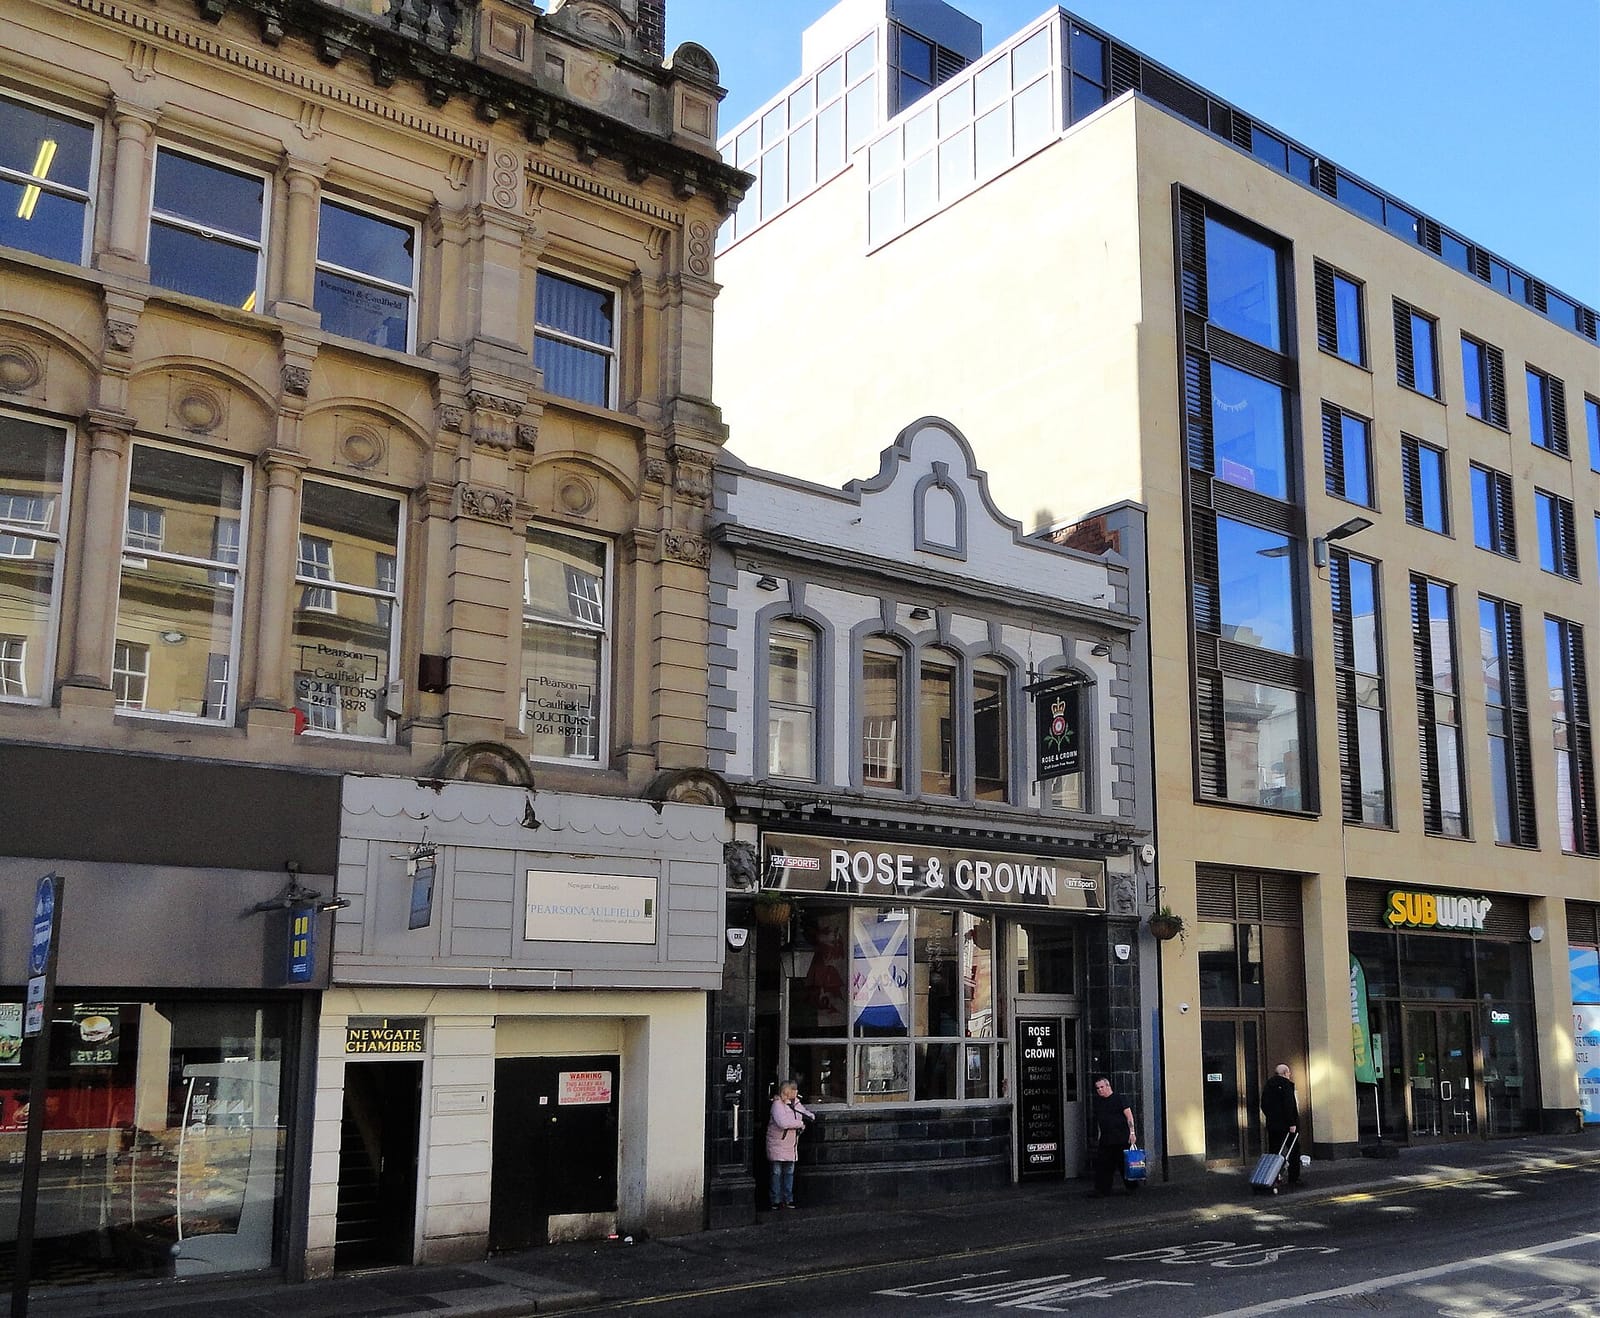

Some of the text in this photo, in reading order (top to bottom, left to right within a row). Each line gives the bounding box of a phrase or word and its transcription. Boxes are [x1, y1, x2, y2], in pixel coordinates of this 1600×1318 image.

[320, 280, 354, 296] Pearson
[318, 644, 362, 660] Pearson
[336, 660, 344, 668] &
[314, 668, 364, 683] Caulfield
[540, 676, 578, 690] Pearson
[556, 690, 562, 698] &
[538, 698, 580, 711] Caulfield
[526, 710, 590, 726] SOLICITORS
[536, 724, 582, 738] 261 8878
[1042, 754, 1054, 764] ROSE
[1060, 750, 1078, 760] CROWN
[787, 858, 818, 868] SPORTS
[830, 849, 1056, 896] ROSE & CROWN
[531, 904, 640, 918] PEARSONCAULFIELD
[1388, 892, 1492, 929] SUBWAY
[1491, 1010, 1510, 1021] Open
[350, 1030, 420, 1040] NEWGATE
[1028, 1026, 1050, 1036] ROSE
[345, 1041, 422, 1052] CHAMBERS
[1036, 1036, 1042, 1046] &
[1024, 1048, 1054, 1058] CROWN
[193, 1094, 208, 1104] HOT
[1104, 1240, 1341, 1268] BUS
[869, 1269, 1195, 1312] LANE
